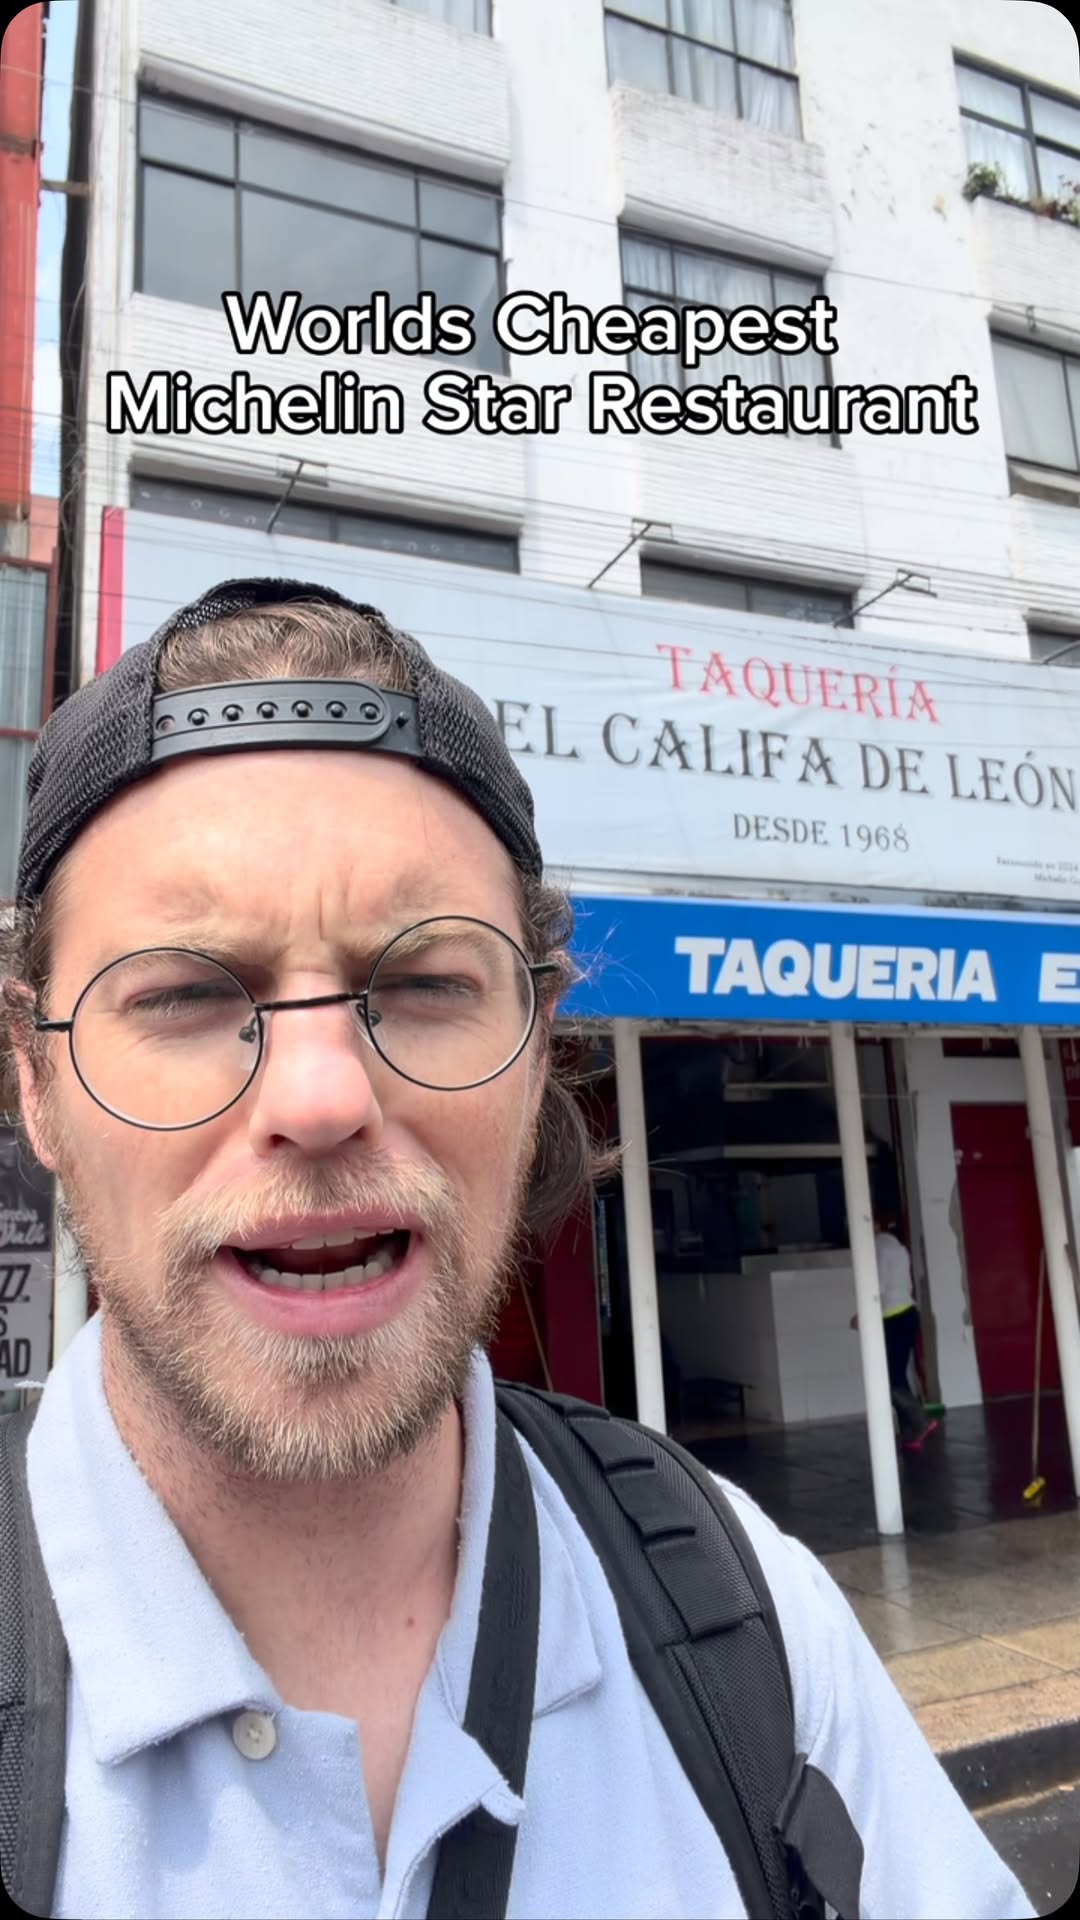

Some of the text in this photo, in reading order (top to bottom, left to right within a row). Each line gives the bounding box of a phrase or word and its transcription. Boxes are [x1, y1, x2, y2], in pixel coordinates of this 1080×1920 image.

[656, 644, 941, 723] TAQUERÍA
[493, 698, 1077, 811] EL CALIFA DE LEÓN
[733, 813, 910, 853] DESDE 1968
[675, 936, 998, 1002] TAQUERIA
